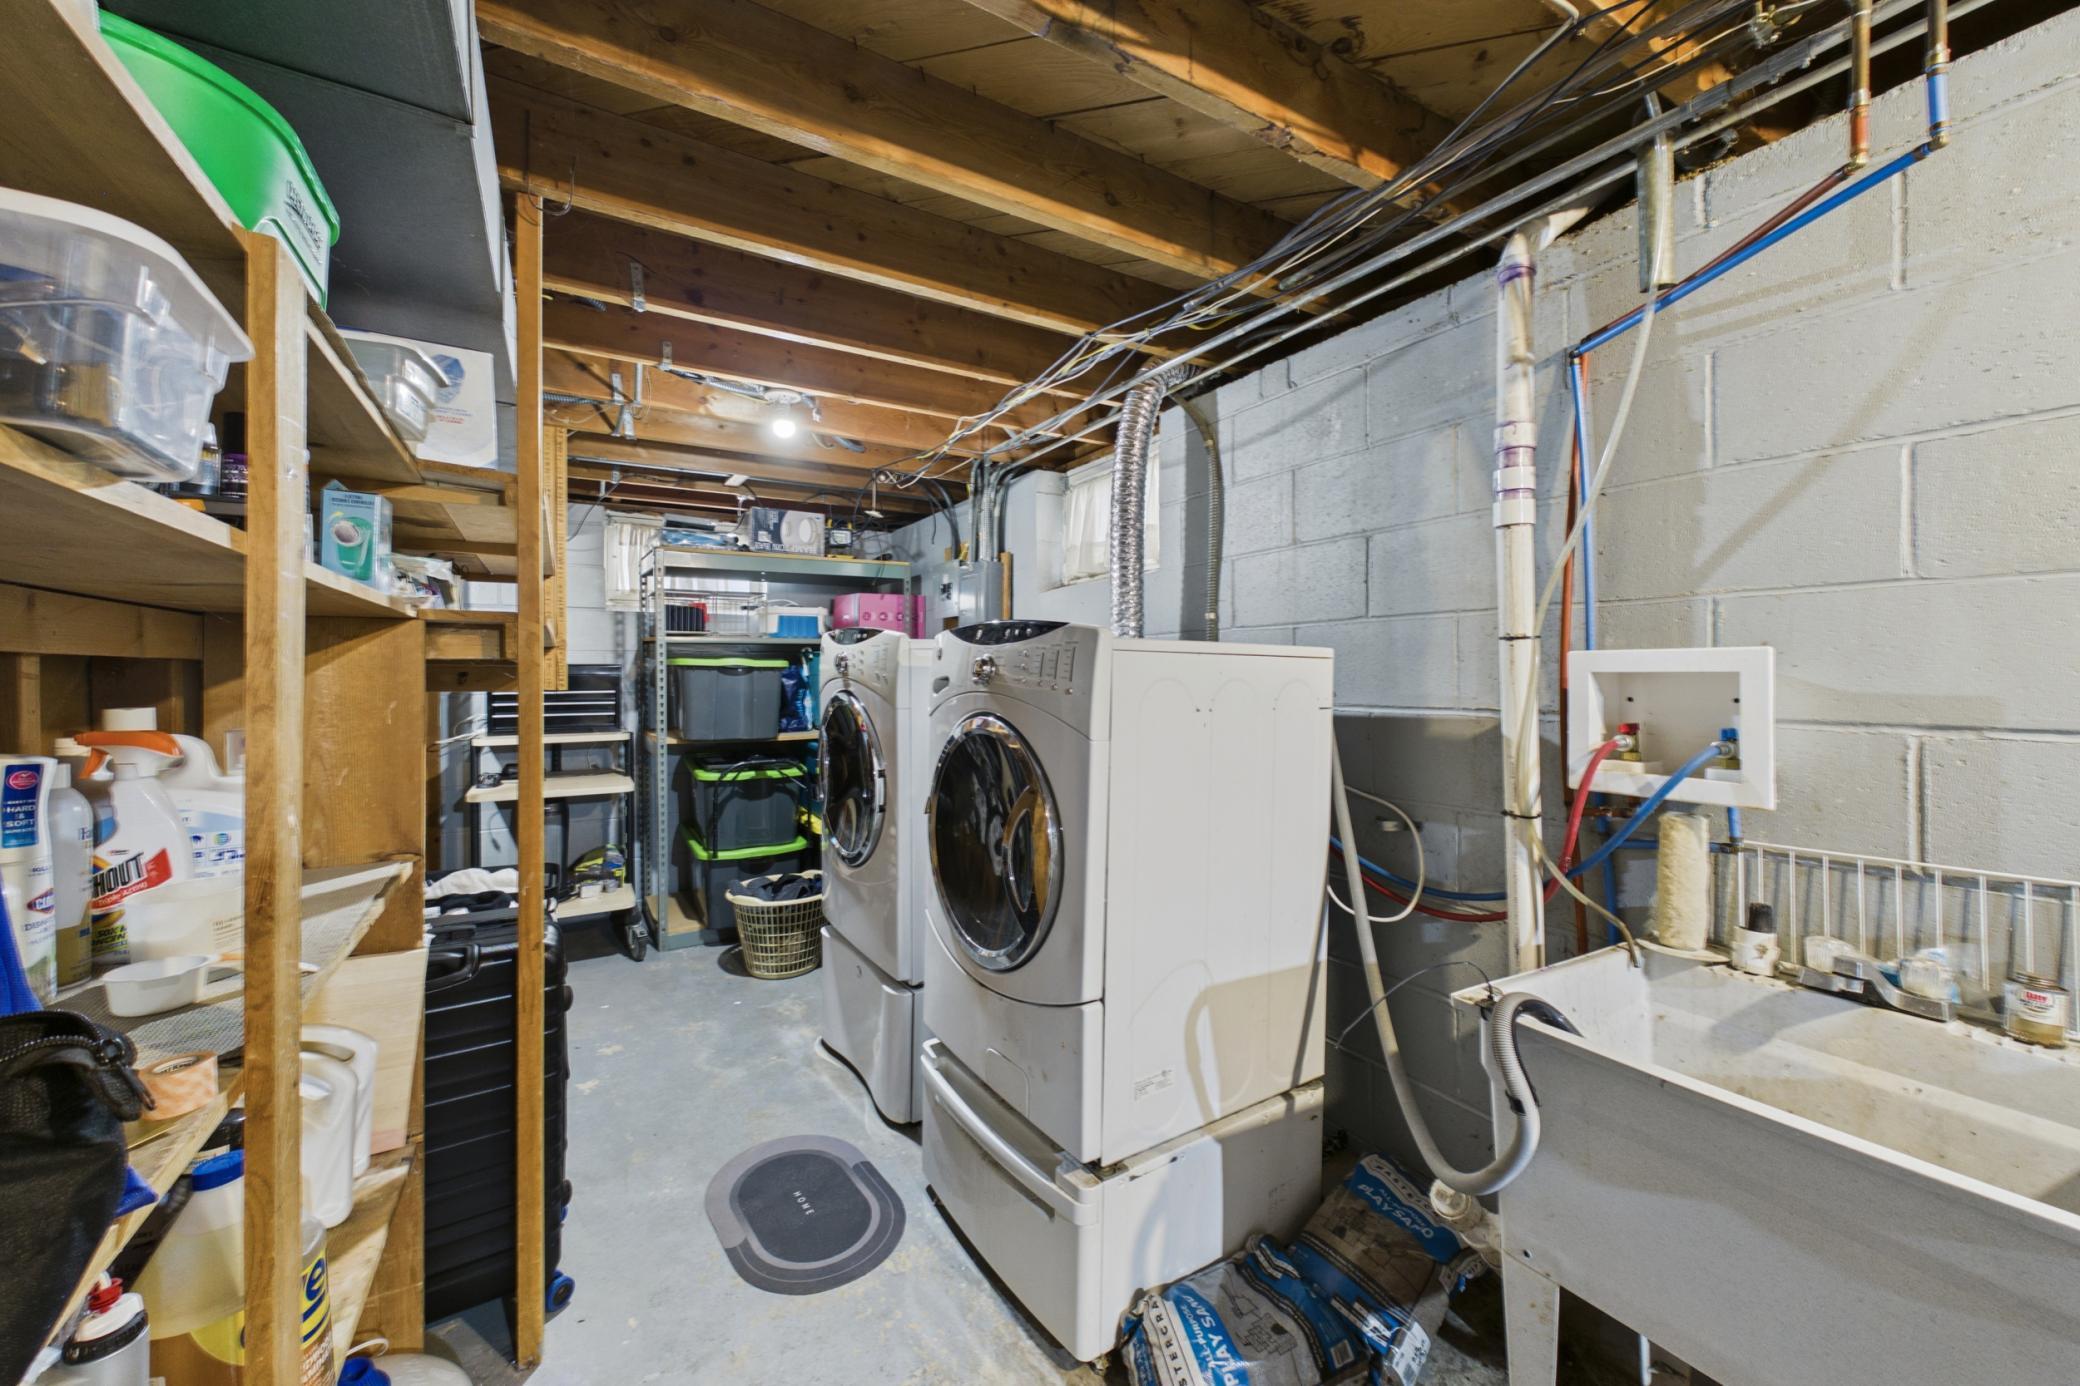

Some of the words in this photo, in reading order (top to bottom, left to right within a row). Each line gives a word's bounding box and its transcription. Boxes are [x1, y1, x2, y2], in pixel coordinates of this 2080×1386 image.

[6, 804, 36, 813] HARD
[92, 851, 144, 899] HOUT
[792, 1190, 815, 1216] HOME
